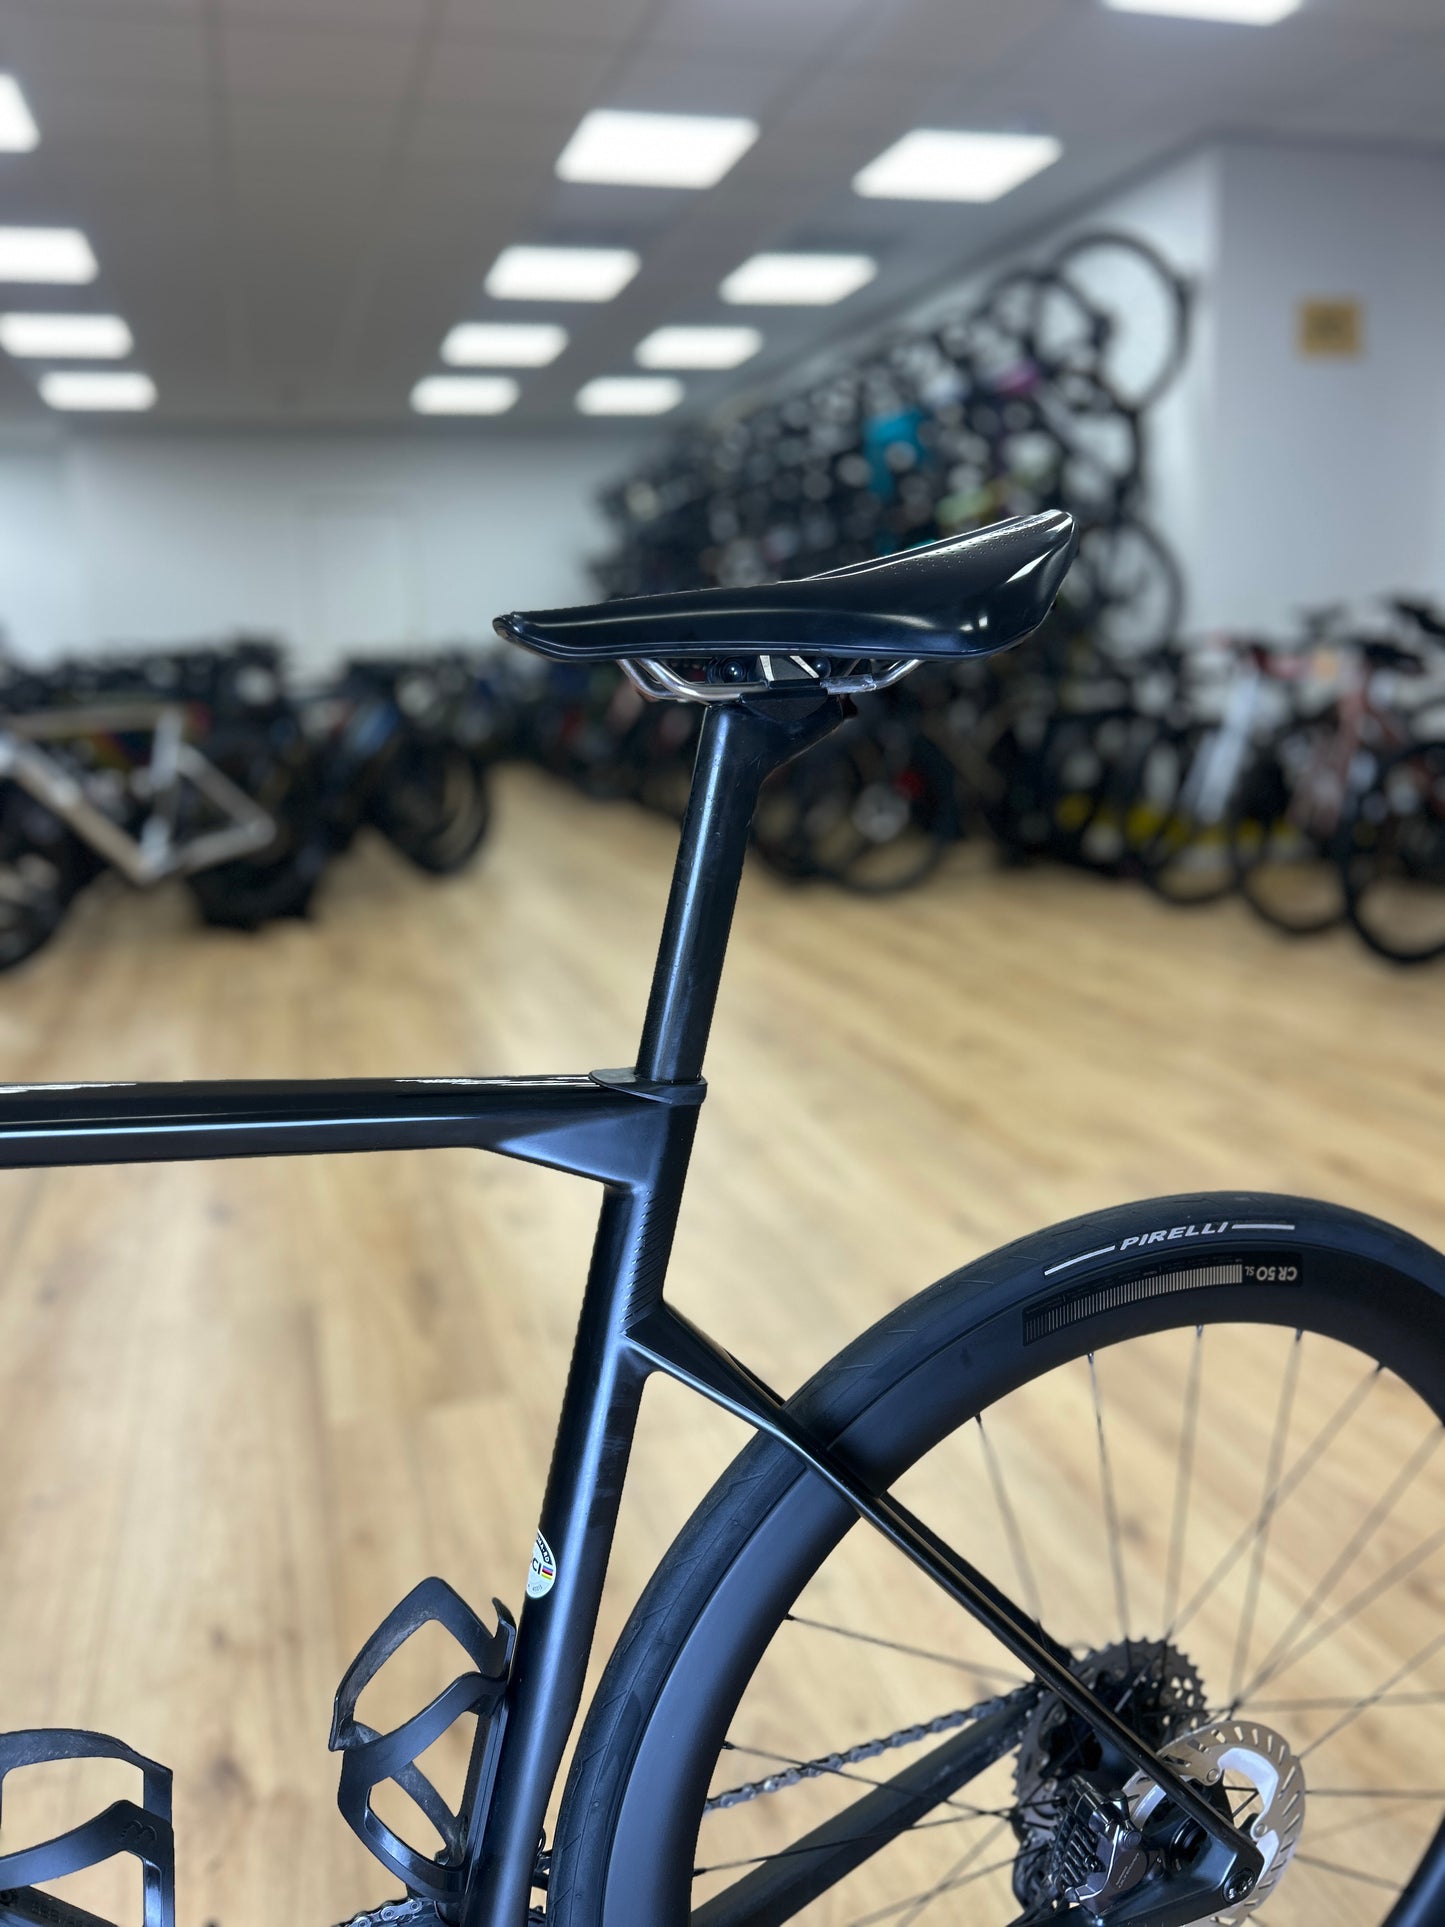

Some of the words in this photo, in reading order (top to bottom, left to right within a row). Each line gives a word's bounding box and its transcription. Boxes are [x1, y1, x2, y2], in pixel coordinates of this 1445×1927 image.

[1120, 1222, 1229, 1251] PIRELLI
[1245, 1266, 1254, 1277] SL
[1256, 1265, 1276, 1281] 50
[1278, 1266, 1298, 1281] CR
[531, 1557, 542, 1575] CI
